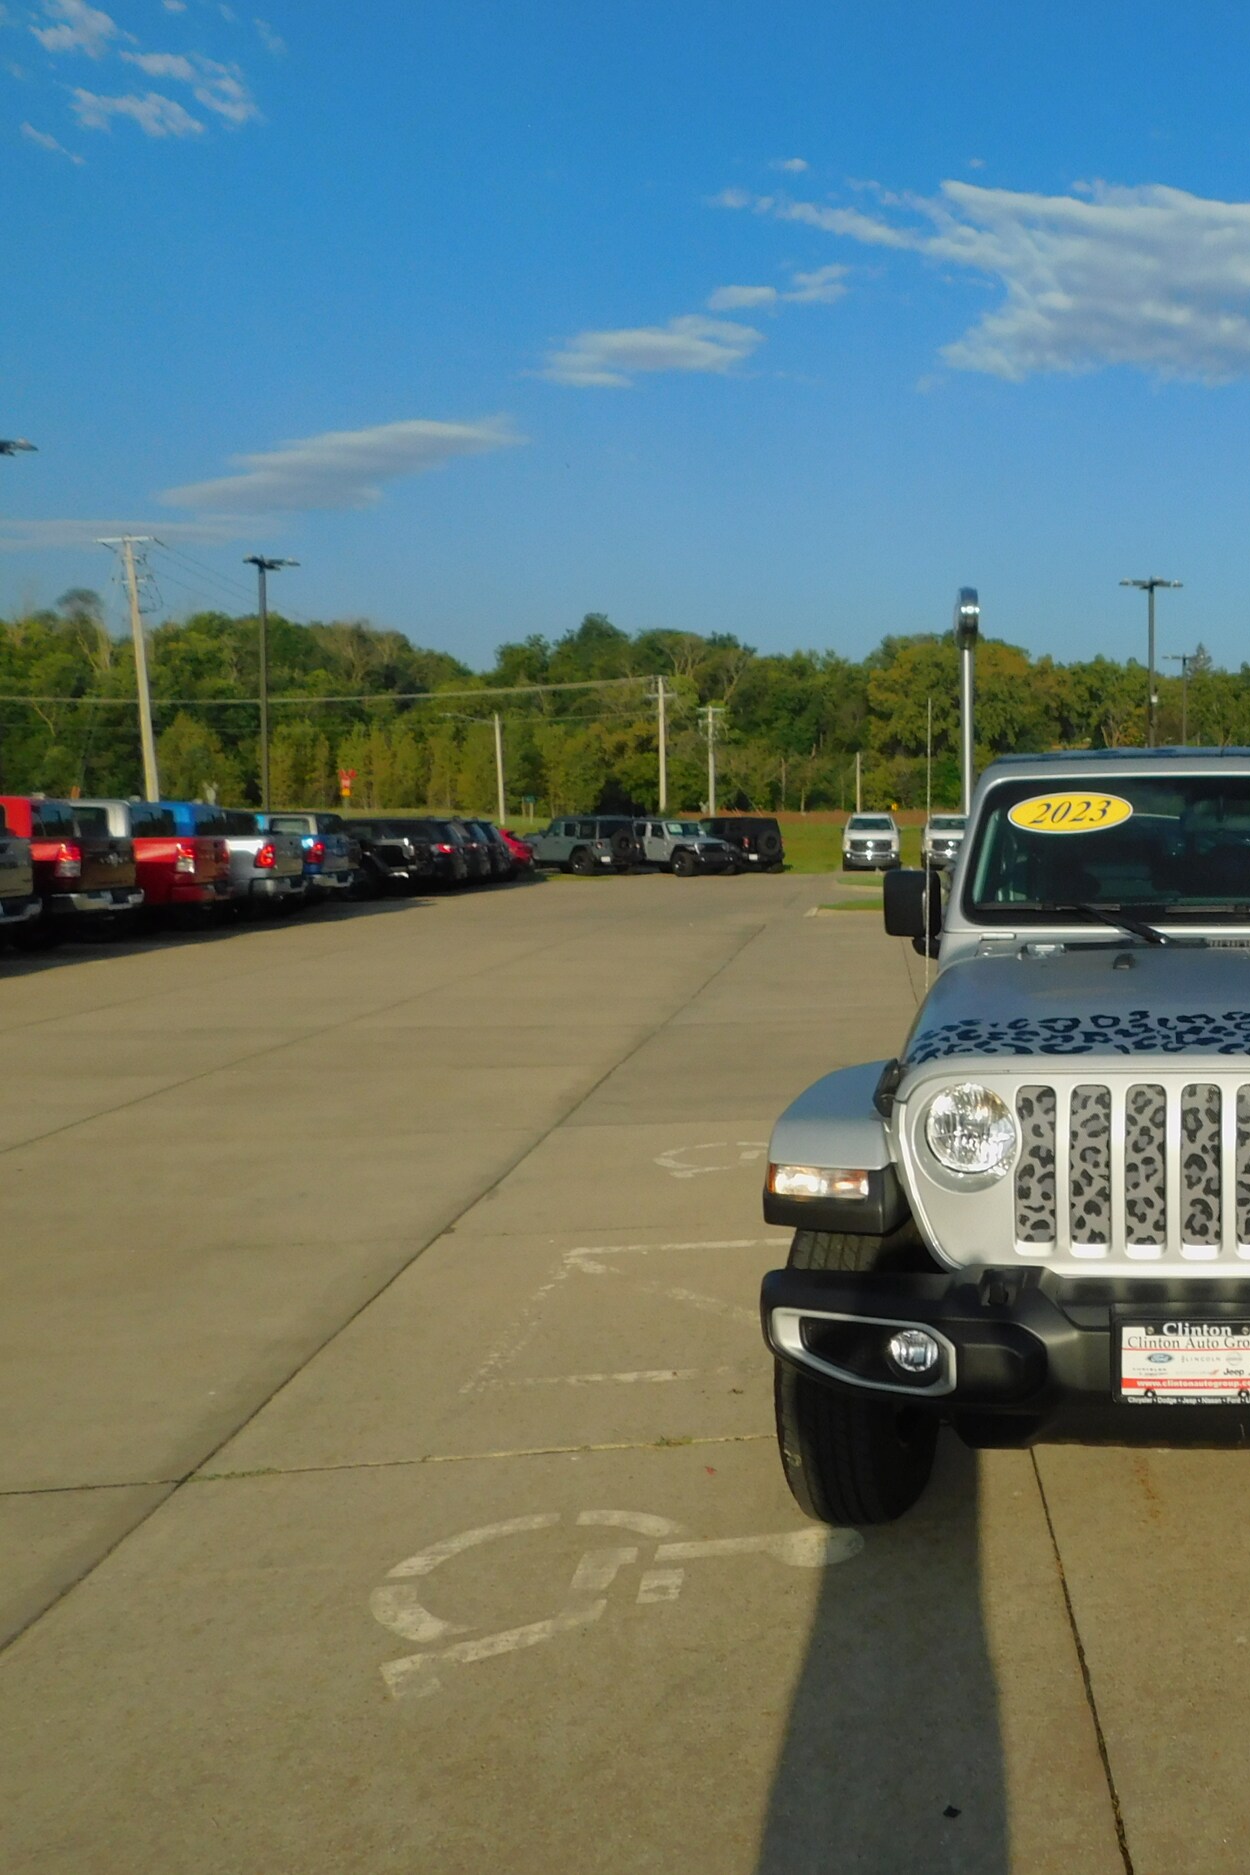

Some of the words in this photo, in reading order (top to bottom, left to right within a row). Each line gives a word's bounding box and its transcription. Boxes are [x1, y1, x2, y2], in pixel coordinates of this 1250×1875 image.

[1028, 800, 1112, 825] 2023
[1162, 1322, 1232, 1337] Clinton
[1127, 1336, 1180, 1349] Clinton
[1185, 1337, 1219, 1349] Auto
[1223, 1368, 1244, 1377] Jeep
